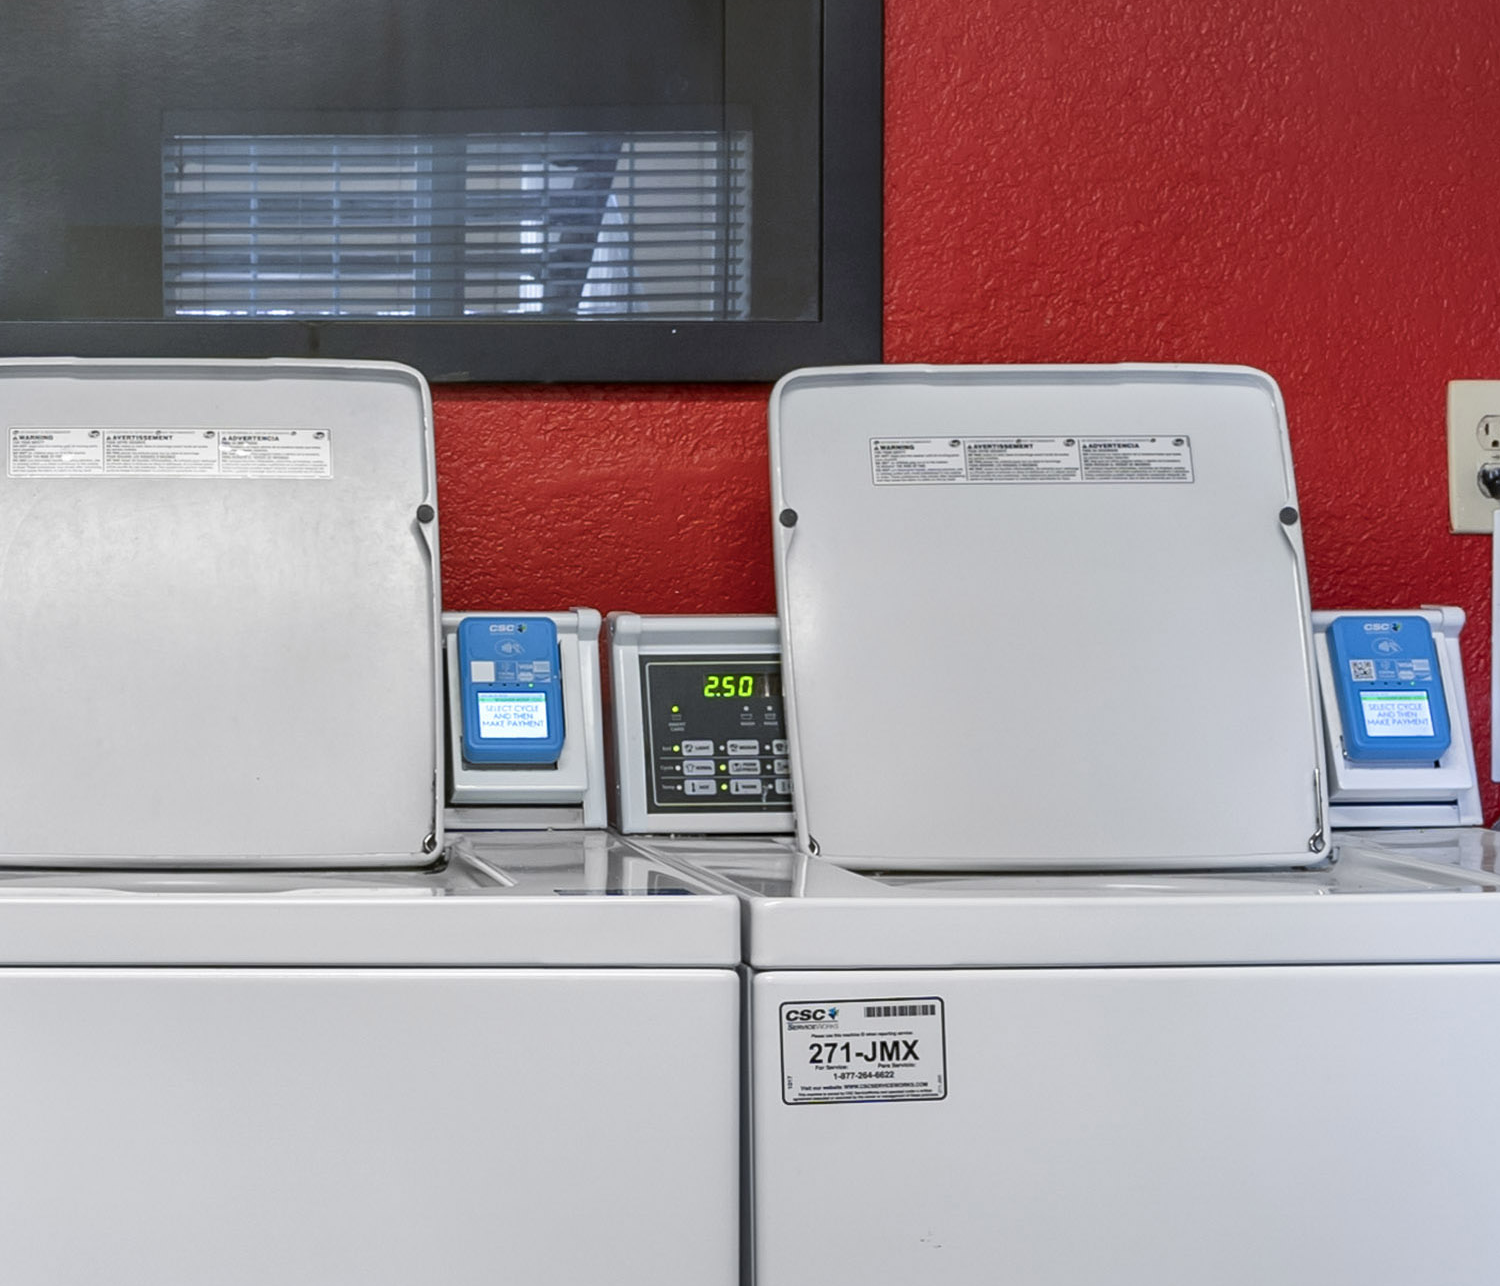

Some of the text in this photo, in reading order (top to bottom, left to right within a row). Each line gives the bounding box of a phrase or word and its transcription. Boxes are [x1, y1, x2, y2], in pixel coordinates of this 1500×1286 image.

[489, 624, 515, 632] CSC
[1364, 623, 1390, 631] CSC
[704, 676, 753, 697] 2.50
[786, 1009, 825, 1021] CSC
[809, 1040, 919, 1064] 271-JMX
